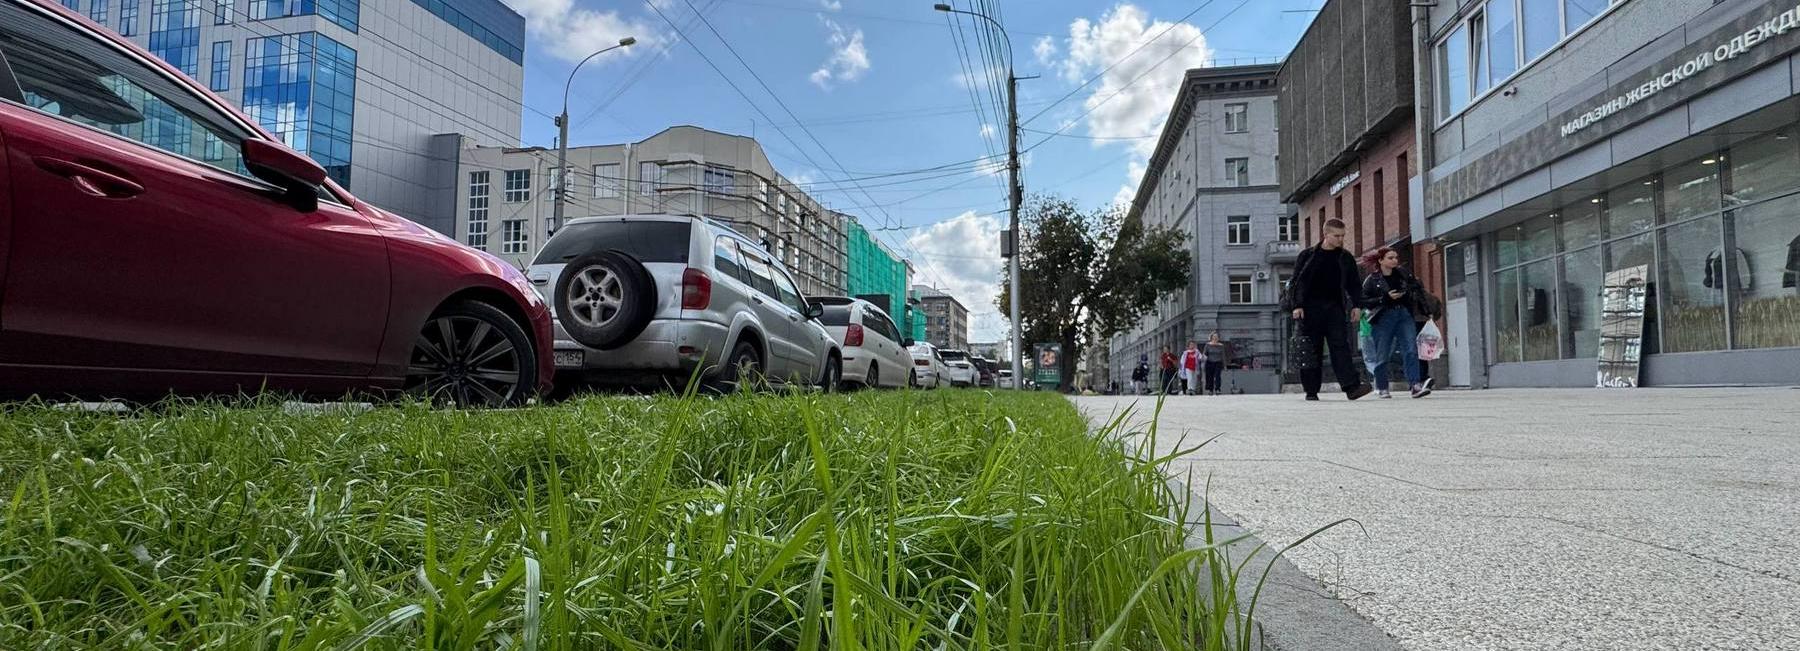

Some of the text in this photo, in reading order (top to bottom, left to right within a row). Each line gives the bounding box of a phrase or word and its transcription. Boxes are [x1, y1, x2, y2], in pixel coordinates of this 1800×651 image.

[1561, 5, 1800, 137] МАГАЗИН ЖЕНСКОЙ ОДЕЖД
